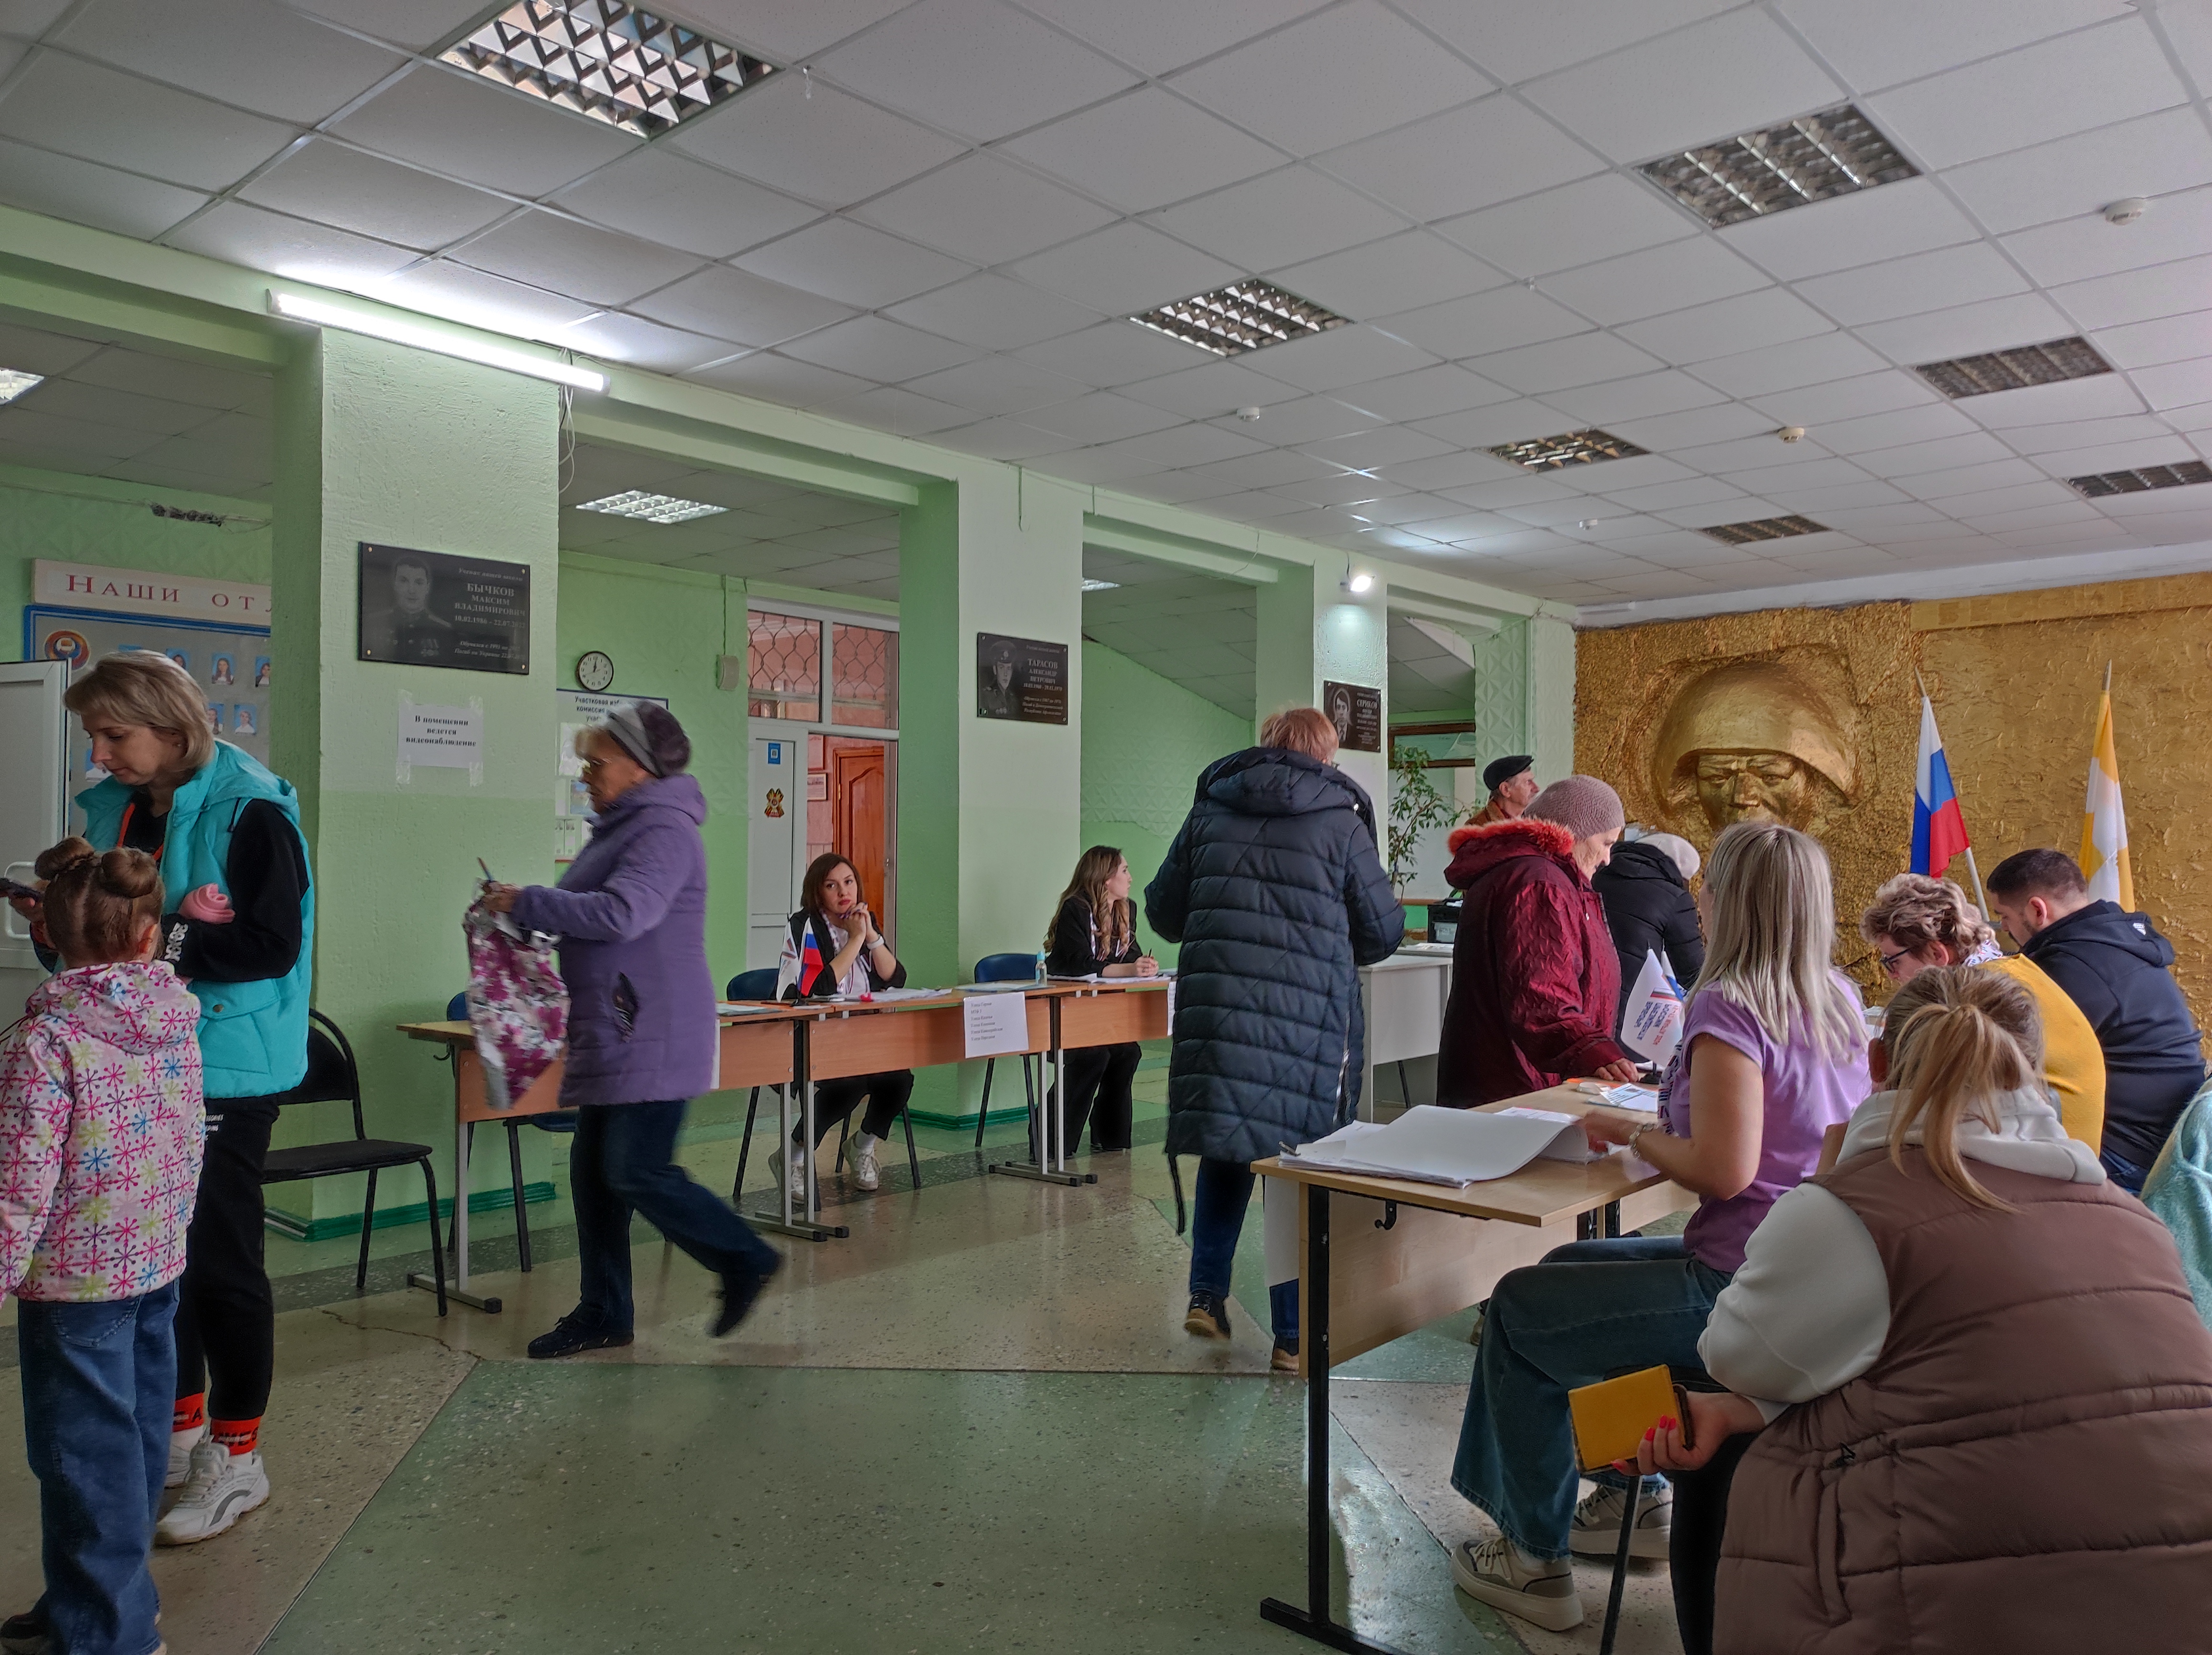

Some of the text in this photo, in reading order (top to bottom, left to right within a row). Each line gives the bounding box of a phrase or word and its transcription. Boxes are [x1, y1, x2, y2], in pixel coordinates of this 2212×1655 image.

[66, 574, 271, 613] НАШИ ОТ
[467, 583, 514, 597] БЫЧКОВ
[471, 594, 510, 606] МАКСИМ
[455, 602, 525, 616] ВЛАДИМИРОВИЧ
[1027, 658, 1058, 669] ТАРАСОВ
[1029, 668, 1057, 677] АЛЕКСАНДР
[1030, 676, 1055, 684] ПЕТРОВИЧ
[574, 695, 608, 705] Участковая
[576, 705, 605, 714] комиссия
[423, 717, 468, 725] помещении
[406, 737, 476, 746] видеонаблюдение
